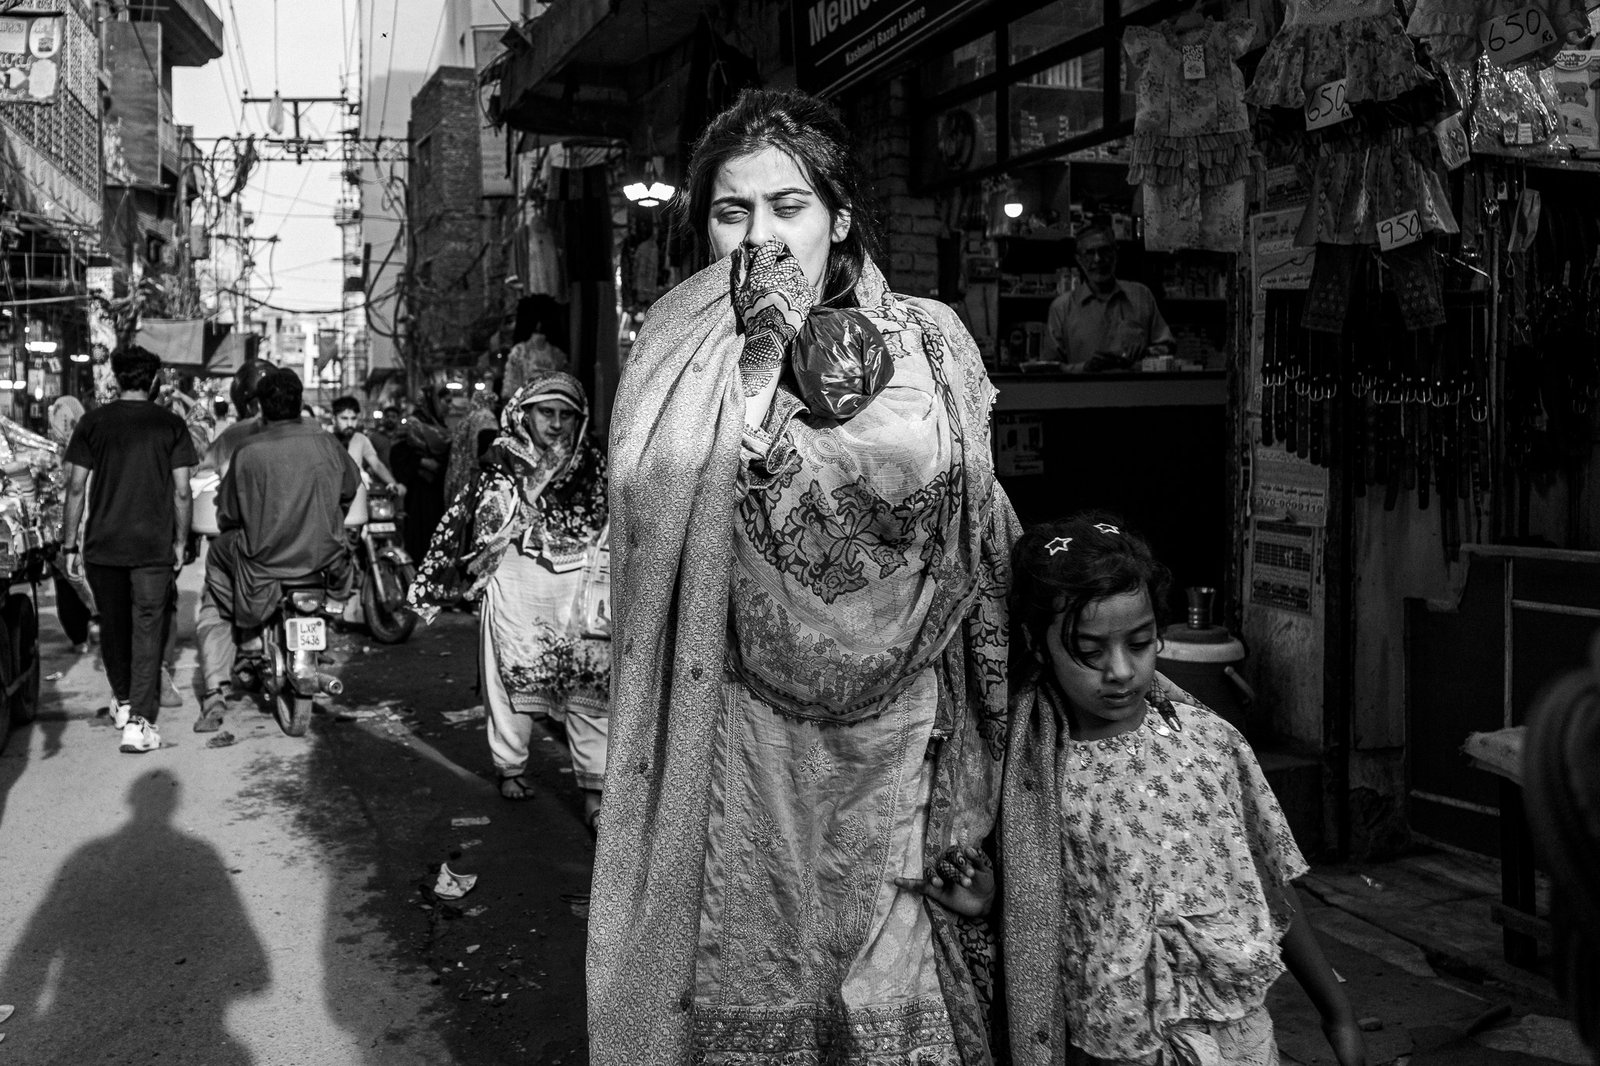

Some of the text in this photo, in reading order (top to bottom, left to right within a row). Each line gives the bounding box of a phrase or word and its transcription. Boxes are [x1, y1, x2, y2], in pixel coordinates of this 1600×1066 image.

[808, 0, 878, 46] Medi
[845, 6, 926, 66] Kashmiri Bazar Lahore
[1488, 9, 1553, 52] 650 Rs
[1307, 83, 1346, 122] 650
[1380, 213, 1420, 244] 950
